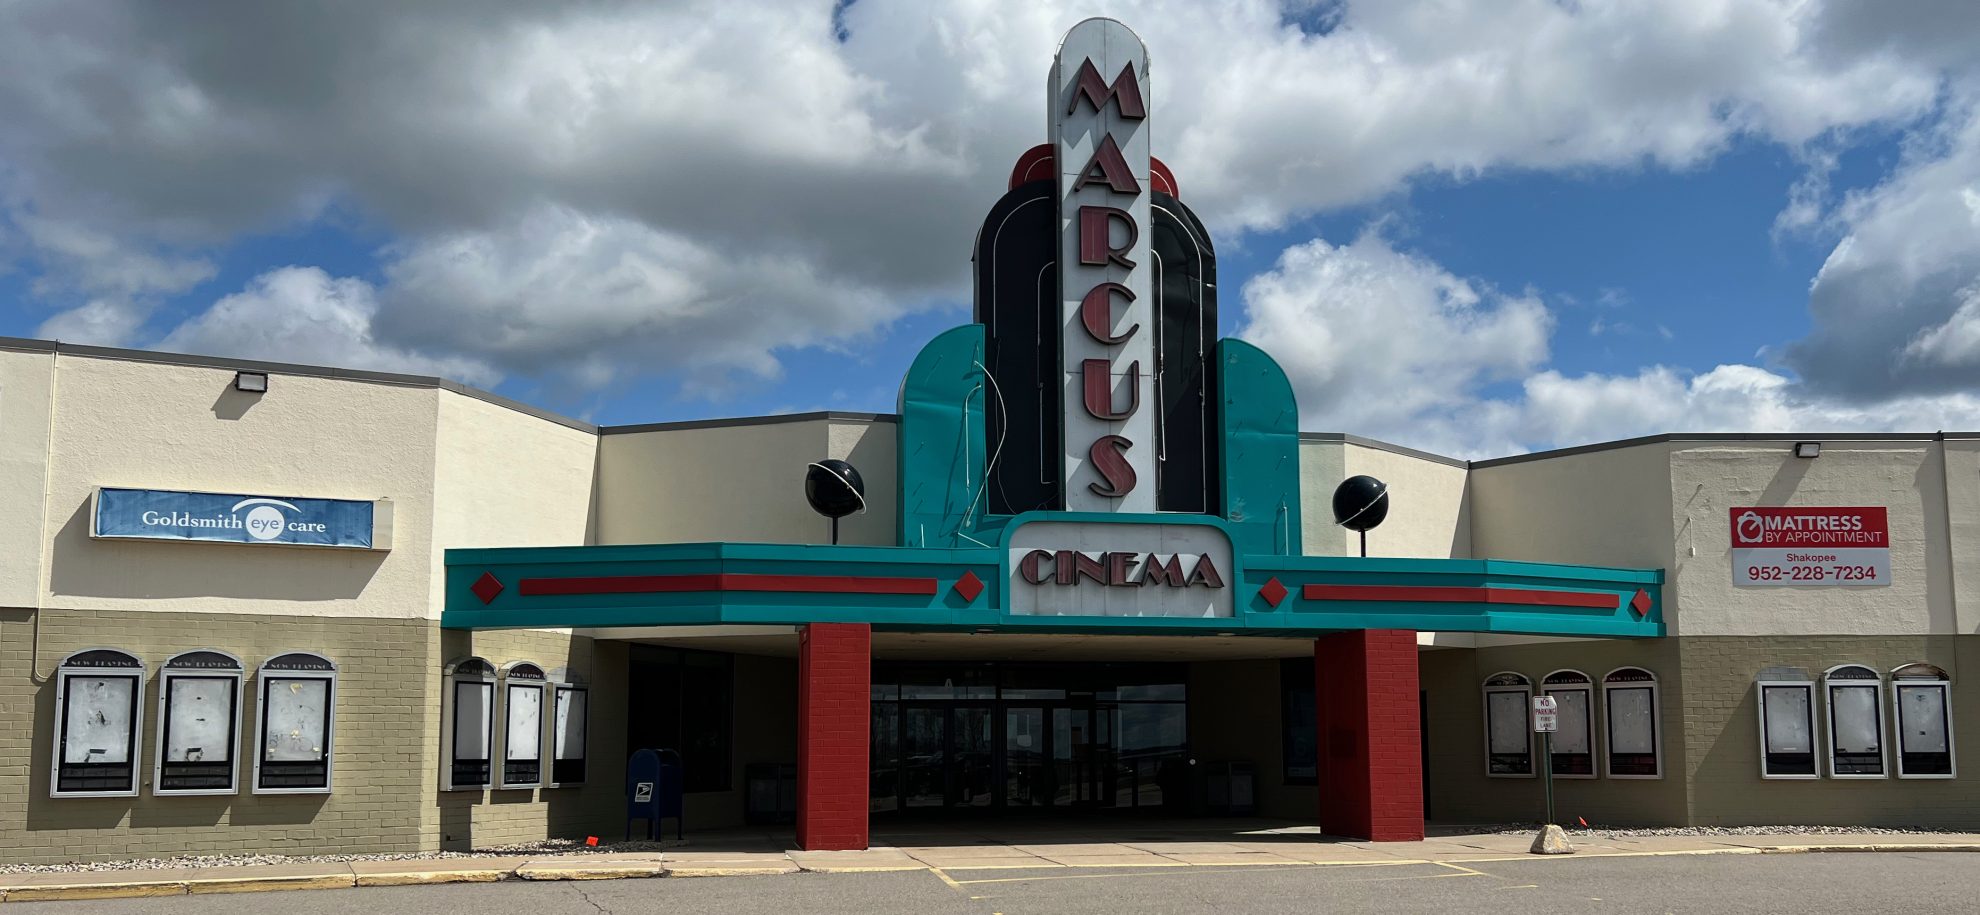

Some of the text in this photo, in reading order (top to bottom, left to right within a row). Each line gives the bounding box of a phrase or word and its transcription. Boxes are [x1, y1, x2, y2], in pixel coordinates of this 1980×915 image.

[1067, 56, 1147, 498] MARCUS
[141, 511, 326, 533] Goldsmith eye care
[1765, 515, 1862, 531] MATTRESS
[1765, 531, 1883, 543] BY APPOINTMENT
[1786, 553, 1837, 563] Shakopee
[1020, 549, 1225, 589] CINEMA
[1748, 565, 1877, 581] 952-228-7234
[1540, 699, 1549, 707] NO
